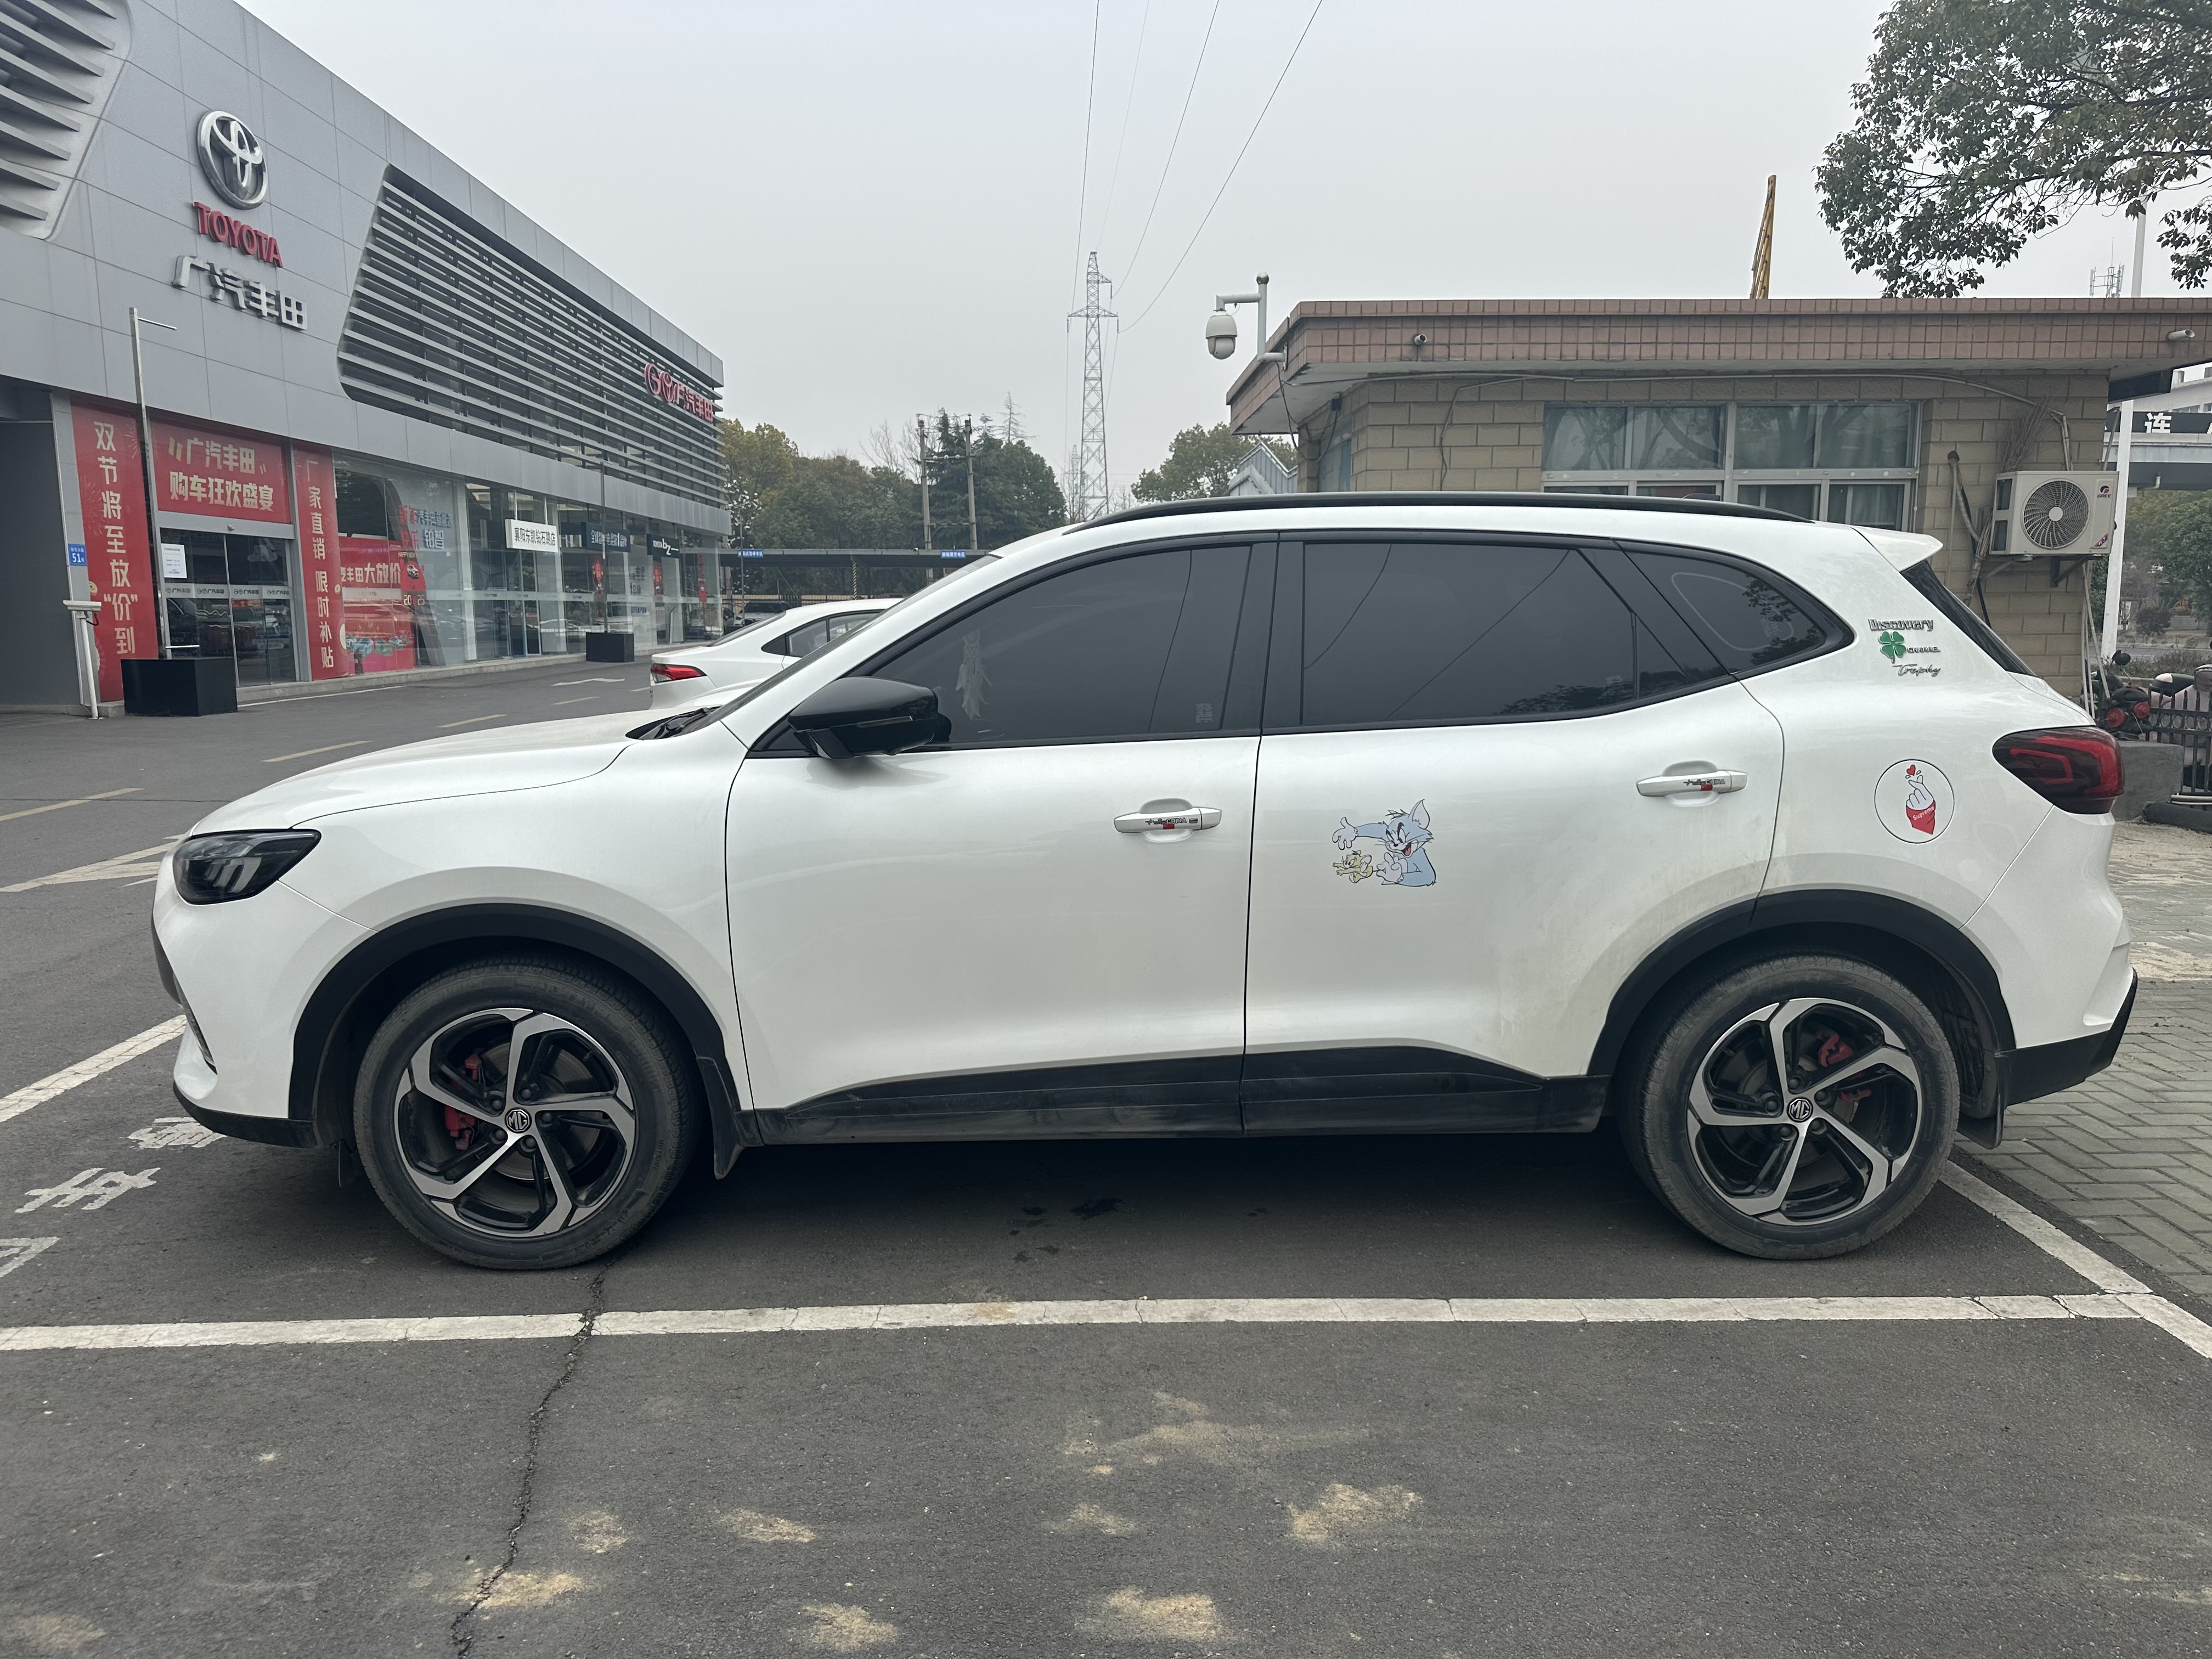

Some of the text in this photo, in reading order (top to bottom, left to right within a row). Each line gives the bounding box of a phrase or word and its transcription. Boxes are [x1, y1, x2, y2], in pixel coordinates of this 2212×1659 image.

[193, 201, 283, 268] TOYOTA
[171, 255, 308, 330] 广汽丰田
[673, 384, 713, 422] 广汽丰田
[170, 471, 274, 512] 购车狂欢盛宴
[305, 461, 334, 669] 厂家直销 限时补贴
[1892, 664, 1941, 678] Trophy
[1912, 806, 1934, 821] Supreme
[507, 1111, 529, 1130] MG
[1791, 1101, 1810, 1119] MG
